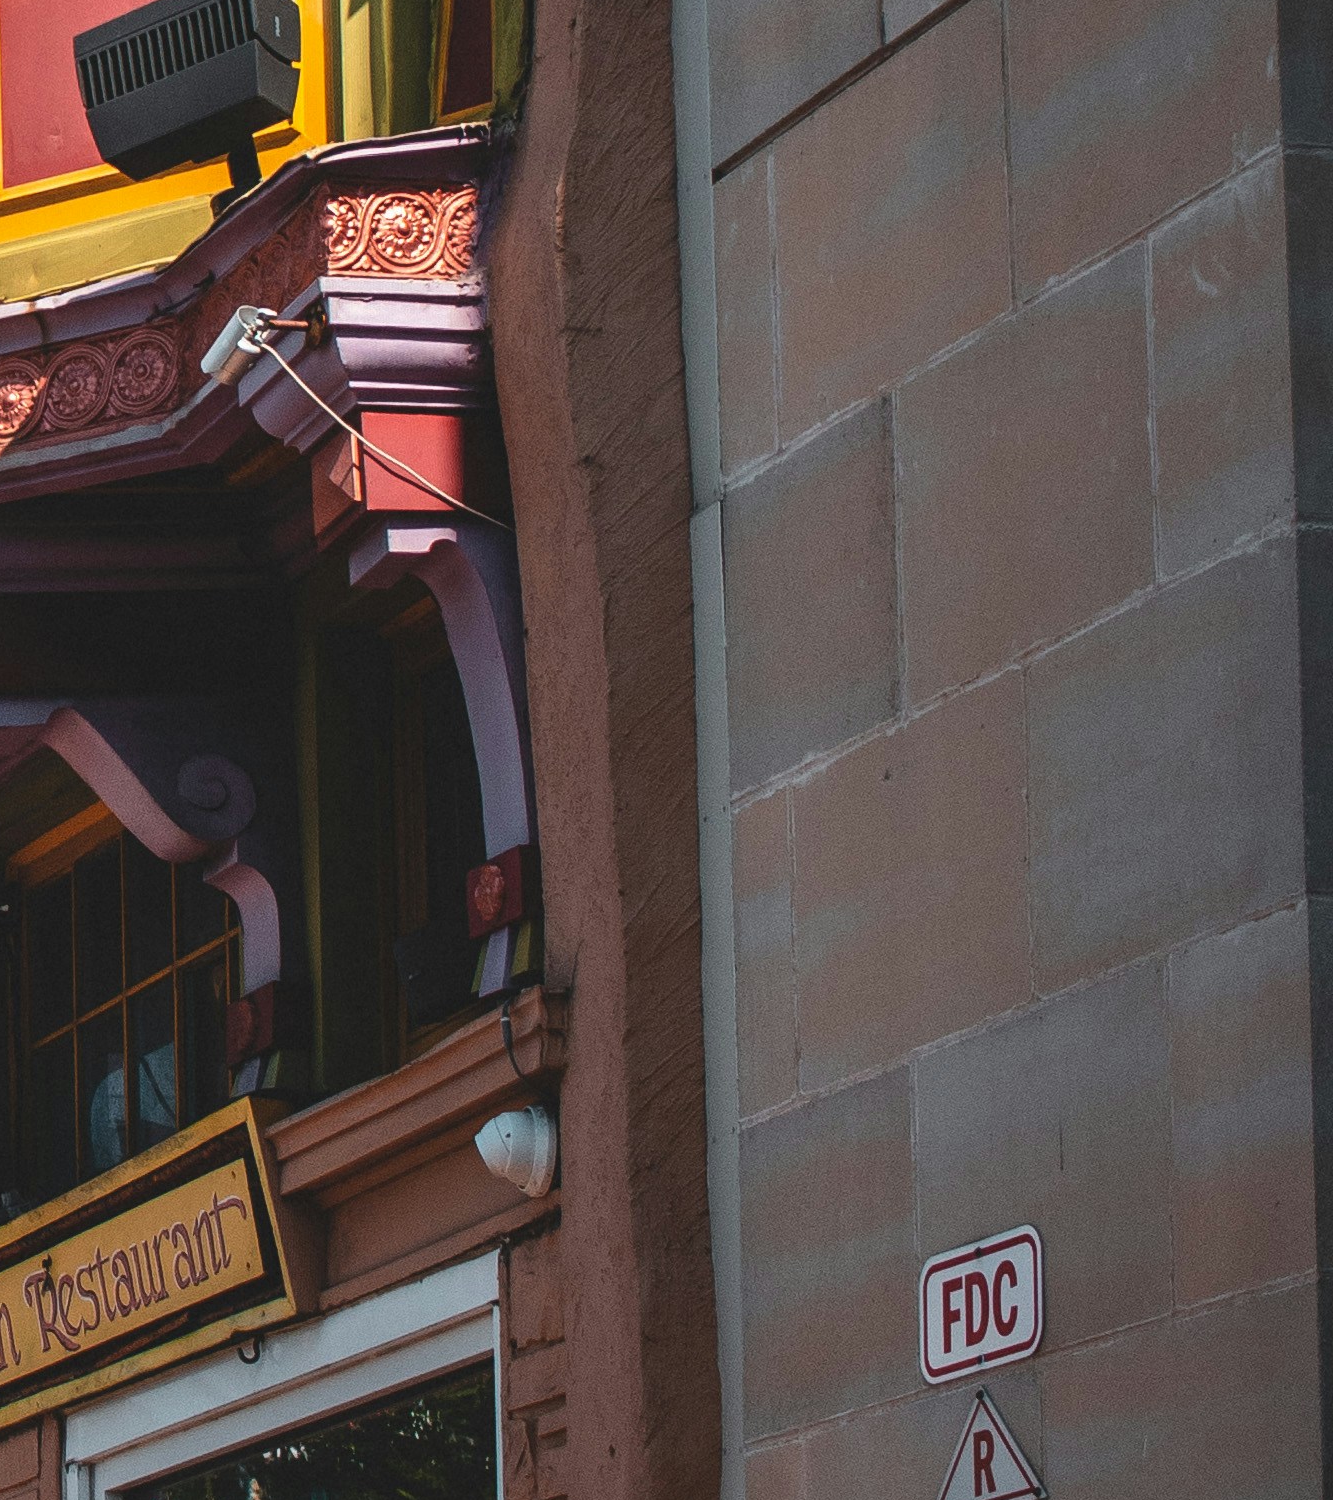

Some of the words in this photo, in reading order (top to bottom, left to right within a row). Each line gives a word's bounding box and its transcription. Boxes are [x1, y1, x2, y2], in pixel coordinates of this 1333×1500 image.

[23, 1193, 248, 1352] Restaurant
[941, 1259, 1019, 1354] FDC
[972, 1428, 997, 1498] R
